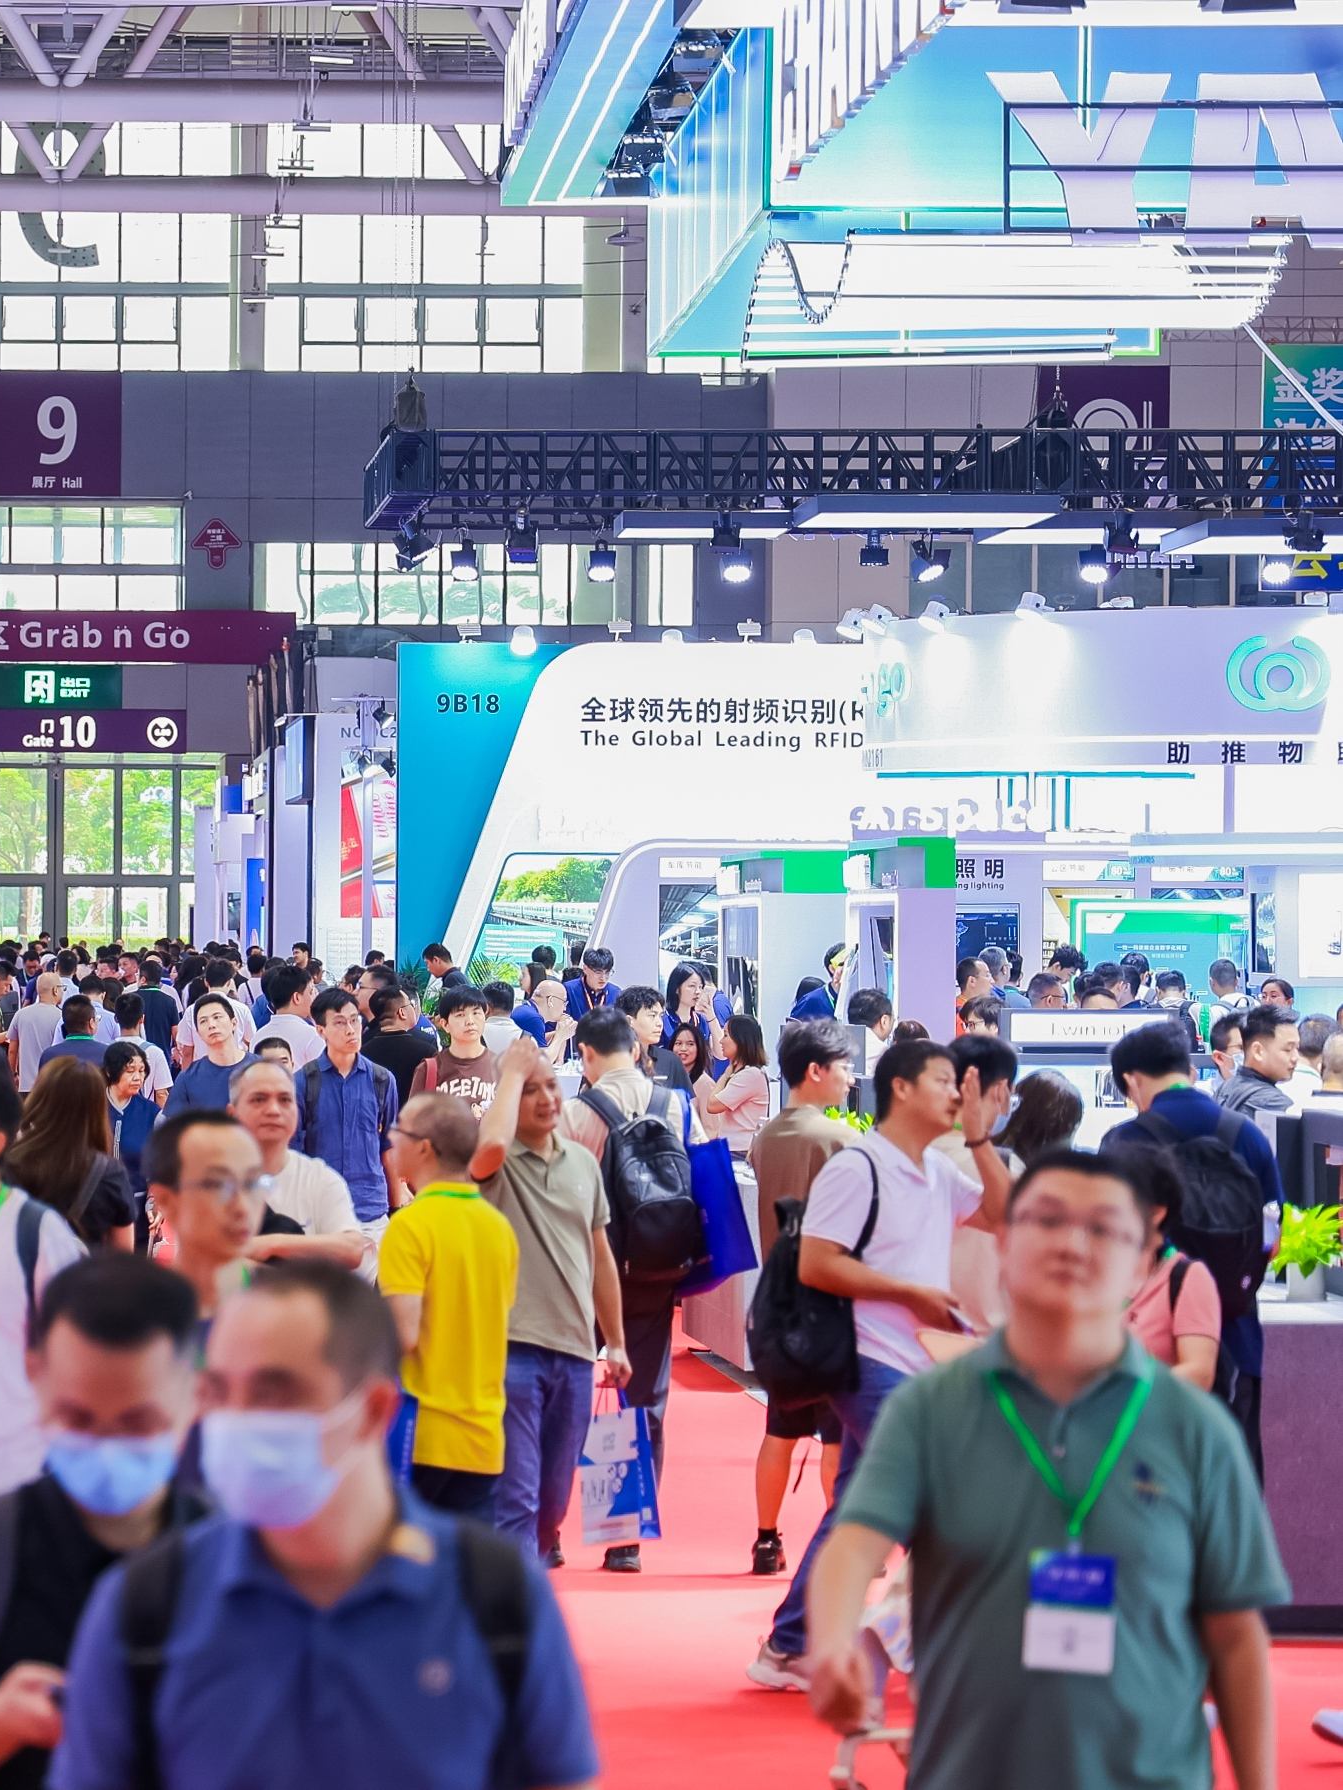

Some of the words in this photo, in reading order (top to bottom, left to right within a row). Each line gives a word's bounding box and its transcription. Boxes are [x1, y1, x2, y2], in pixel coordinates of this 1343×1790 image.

[37, 395, 78, 465] 9
[32, 476, 56, 488] 展厅
[62, 477, 83, 489] Hall
[19, 621, 102, 648] Grab
[113, 627, 133, 648] n
[143, 622, 191, 649] Go
[60, 677, 91, 688] 出口
[60, 688, 90, 698] EXIT
[437, 693, 500, 713] 9B18
[22, 734, 55, 748] Gate
[59, 715, 97, 748] 10
[580, 729, 619, 746] The
[632, 729, 702, 747] Global
[715, 731, 801, 752] Leading
[815, 732, 863, 748] RFID
[955, 858, 1004, 879] 照明
[970, 881, 1005, 891] lighting
